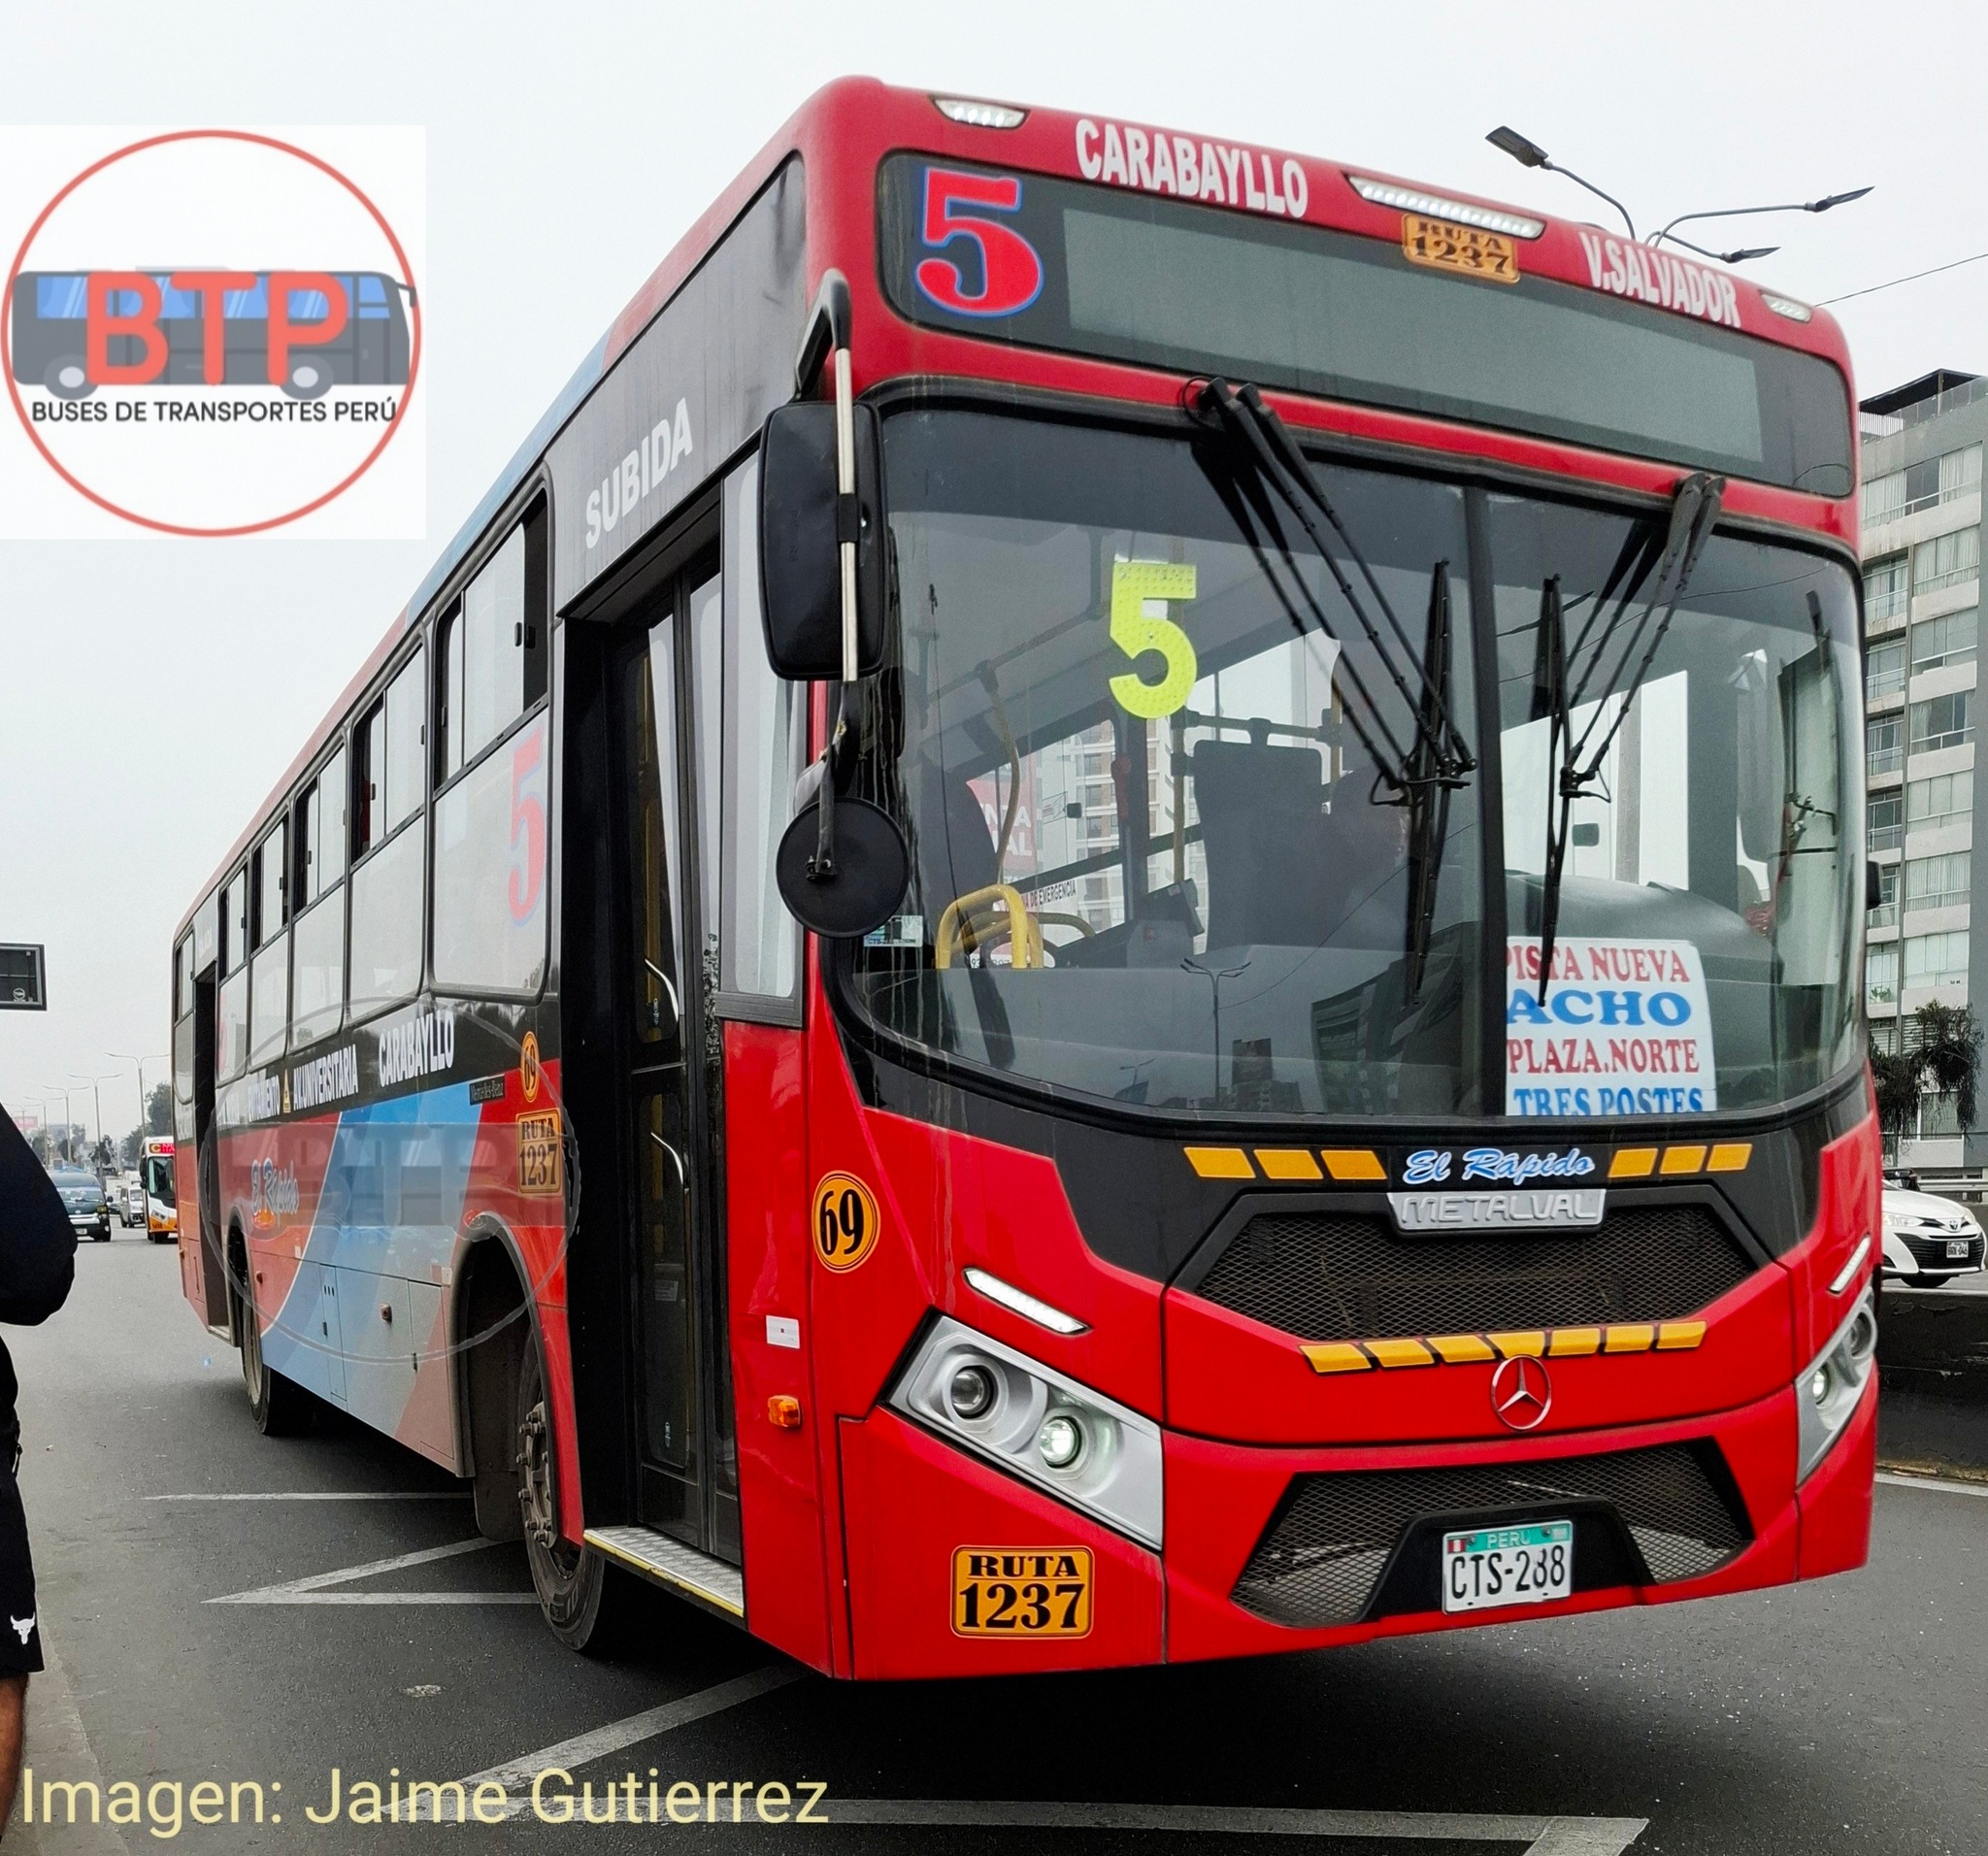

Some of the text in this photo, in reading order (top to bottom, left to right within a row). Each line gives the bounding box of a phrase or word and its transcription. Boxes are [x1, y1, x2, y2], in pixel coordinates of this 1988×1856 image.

[1075, 118, 1309, 218] CARABAYLLO
[914, 167, 1043, 317] 5
[1411, 235, 1509, 274] 1237
[1418, 221, 1501, 249] RUTA
[1578, 231, 1741, 328] V.SALVADOR
[585, 397, 693, 549] SUBIDA
[1109, 562, 1197, 719] 5
[508, 718, 546, 927] 5
[1039, 879, 1077, 906] EMERGENCIA
[1588, 947, 1690, 982] NUEVA
[1507, 988, 1691, 1027] ACHO
[379, 1009, 454, 1087] CARABAYLLO
[1508, 1039, 1700, 1074] PLAZA.NORTE
[522, 1044, 537, 1092] 69
[1513, 1087, 1703, 1116] TRES POSTES
[520, 1117, 556, 1141] RUTA
[518, 1143, 558, 1186] 1237
[1403, 1149, 1452, 1184] El
[819, 1188, 864, 1256] 69
[1402, 1194, 1598, 1223] METALVAL
[1486, 1532, 1531, 1549] PERU
[969, 1554, 1079, 1577] RUTA
[959, 1582, 1085, 1630] 1237
